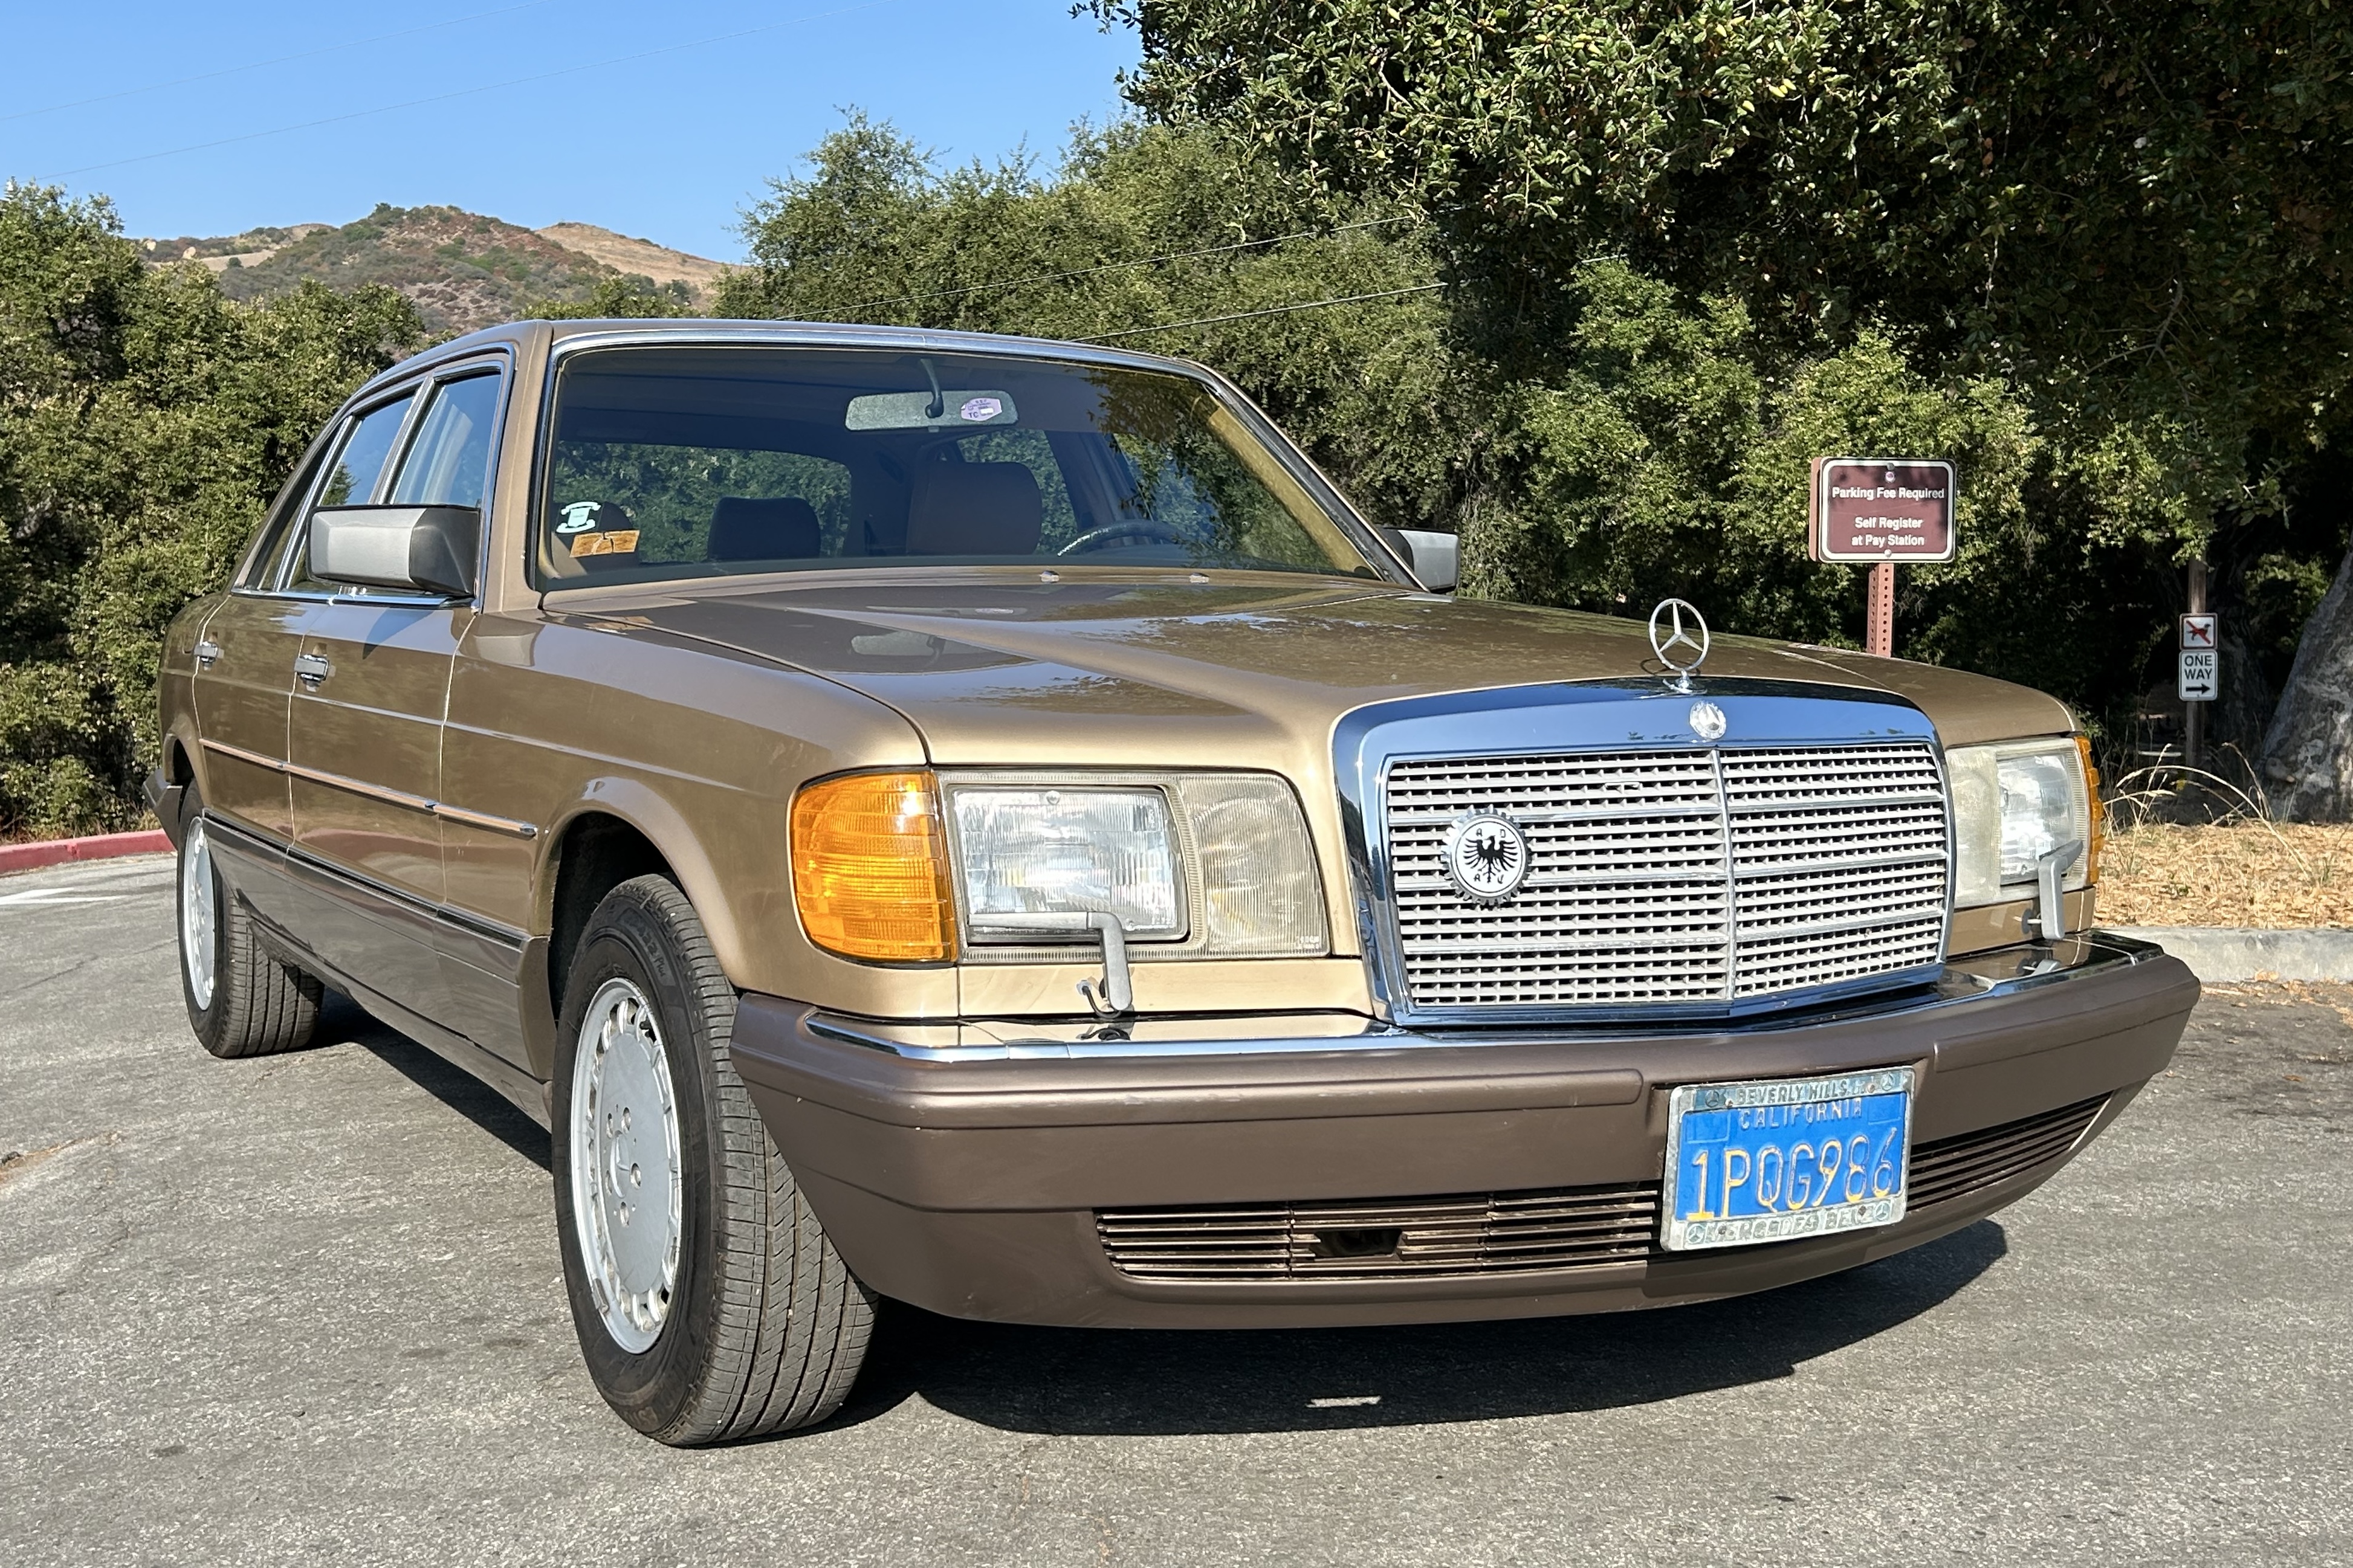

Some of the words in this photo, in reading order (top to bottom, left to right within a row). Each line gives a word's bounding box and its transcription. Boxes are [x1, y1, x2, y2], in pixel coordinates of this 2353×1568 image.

[1832, 486, 1874, 501] Parking
[1877, 487, 1895, 498] Fee
[1899, 487, 1945, 501] Required
[1855, 517, 1877, 528] Self
[1879, 517, 1924, 531] Register
[1851, 535, 1862, 546] at
[1865, 535, 1885, 548] Pay
[1888, 534, 1924, 546] Station
[2184, 655, 2212, 666] ONE
[2184, 668, 2212, 680] WAY
[1736, 1084, 1804, 1105] BEVERLY
[1739, 1097, 1862, 1131] CALIFORNIA
[1687, 1127, 1897, 1221] 1PQG986
